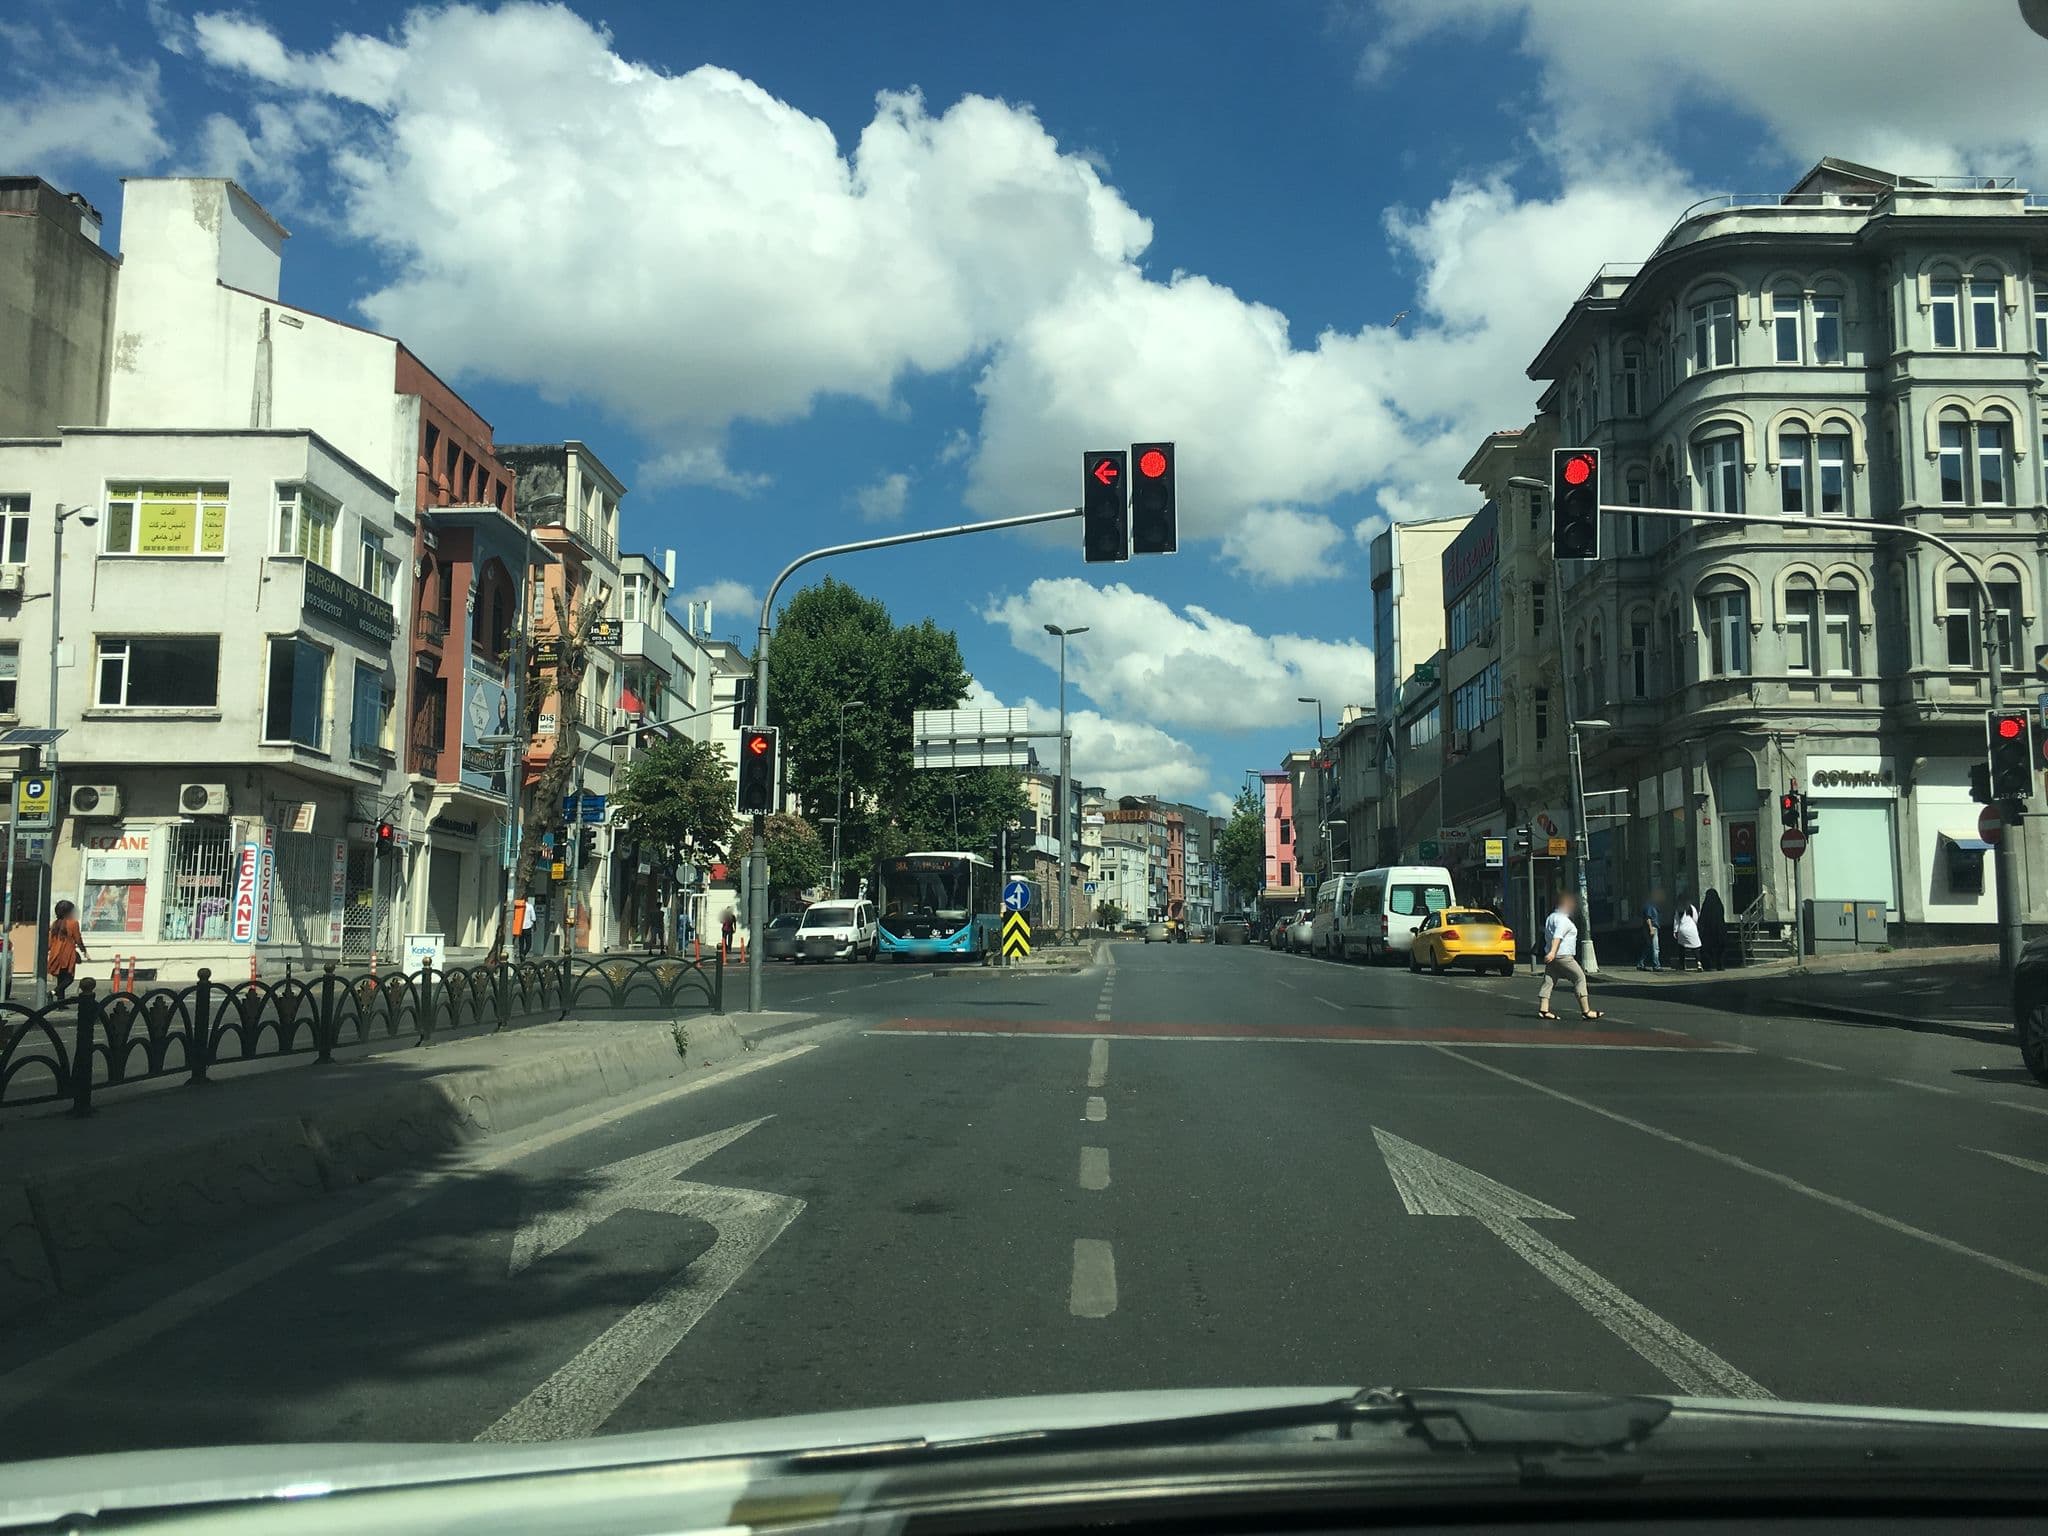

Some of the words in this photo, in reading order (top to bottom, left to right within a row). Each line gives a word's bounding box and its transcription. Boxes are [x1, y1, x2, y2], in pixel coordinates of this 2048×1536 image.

[307, 568, 343, 600] BURGAN
[29, 784, 41, 795] P
[90, 836, 149, 851] ECZANE
[236, 849, 256, 937] ECZANE
[261, 854, 272, 927] ECZANE
